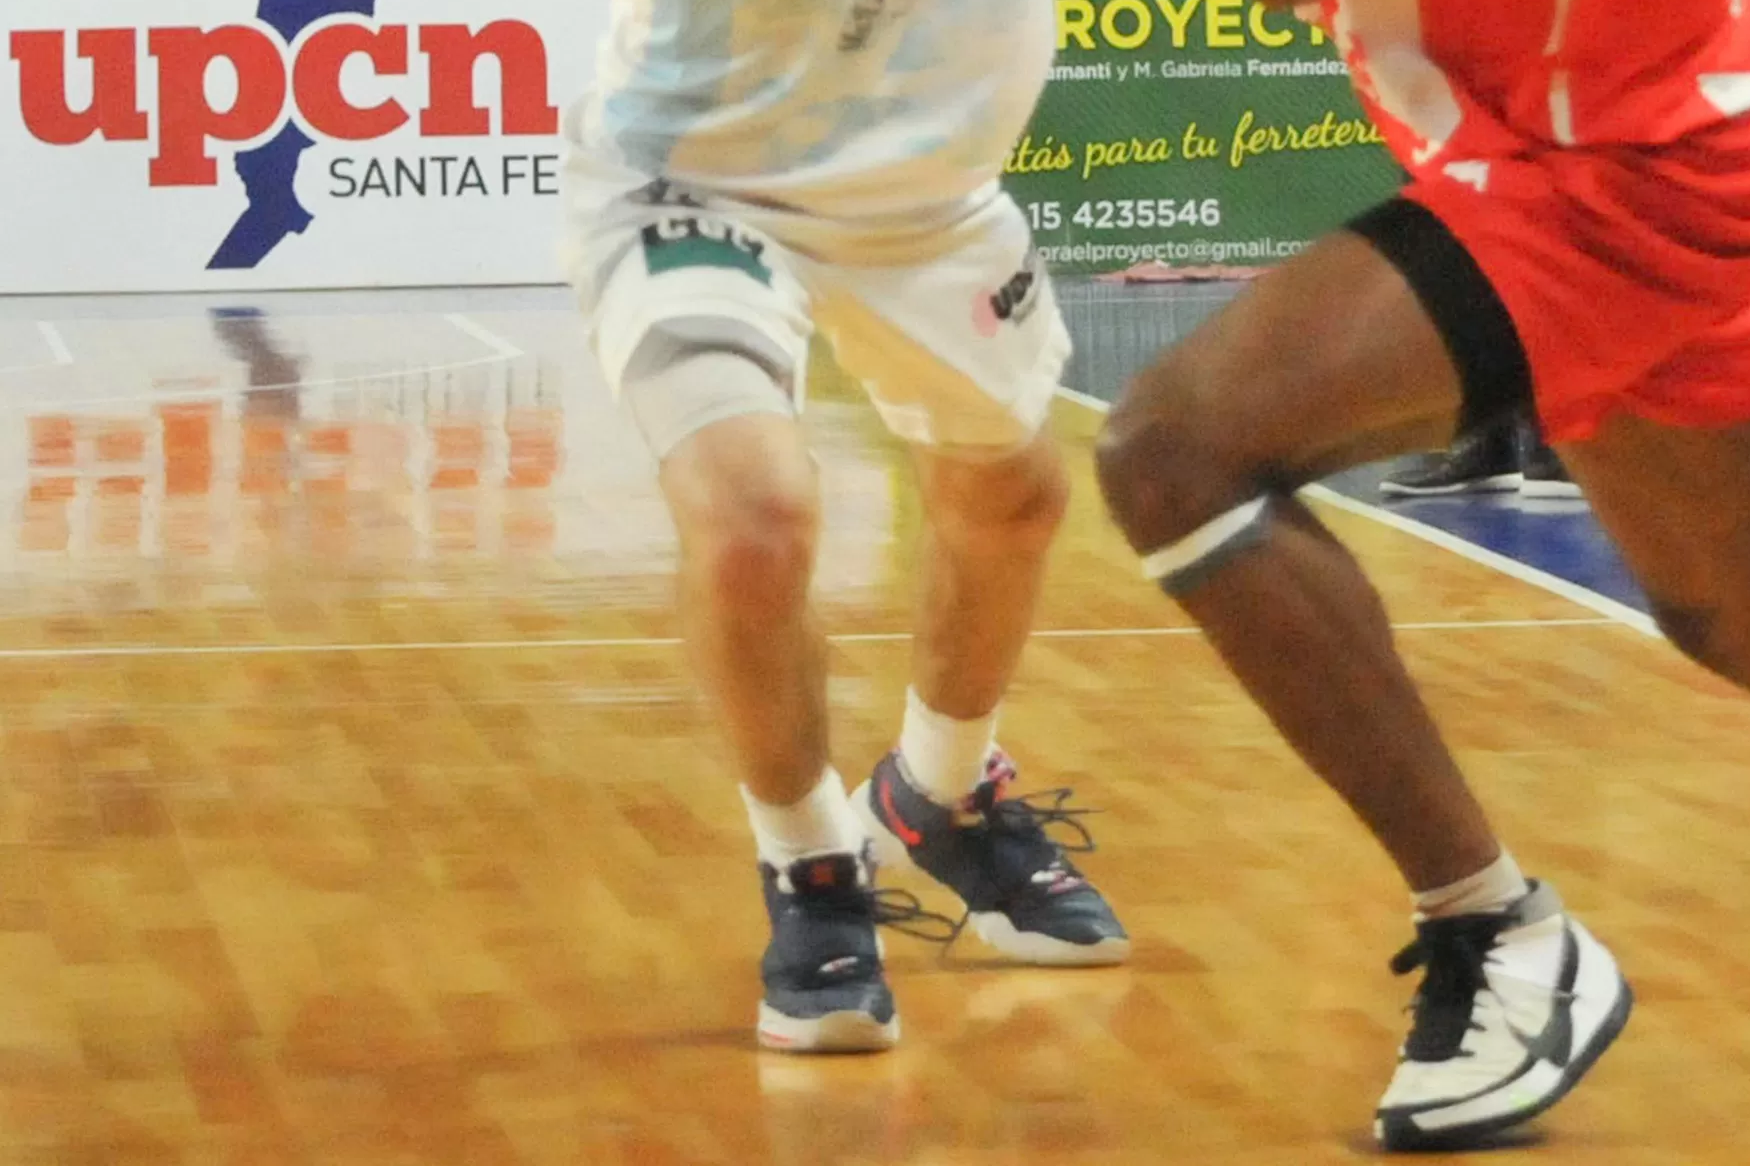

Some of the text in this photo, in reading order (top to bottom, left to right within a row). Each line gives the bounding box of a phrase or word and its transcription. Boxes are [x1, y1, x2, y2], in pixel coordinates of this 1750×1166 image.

[1116, 65, 1129, 83] y
[1161, 60, 1242, 79] Gabriela
[10, 19, 560, 186] upcn
[1082, 135, 1170, 179] para
[1182, 122, 1219, 159] tu
[329, 155, 560, 197] SANTA FE
[1028, 198, 1221, 231] 15 4235546
